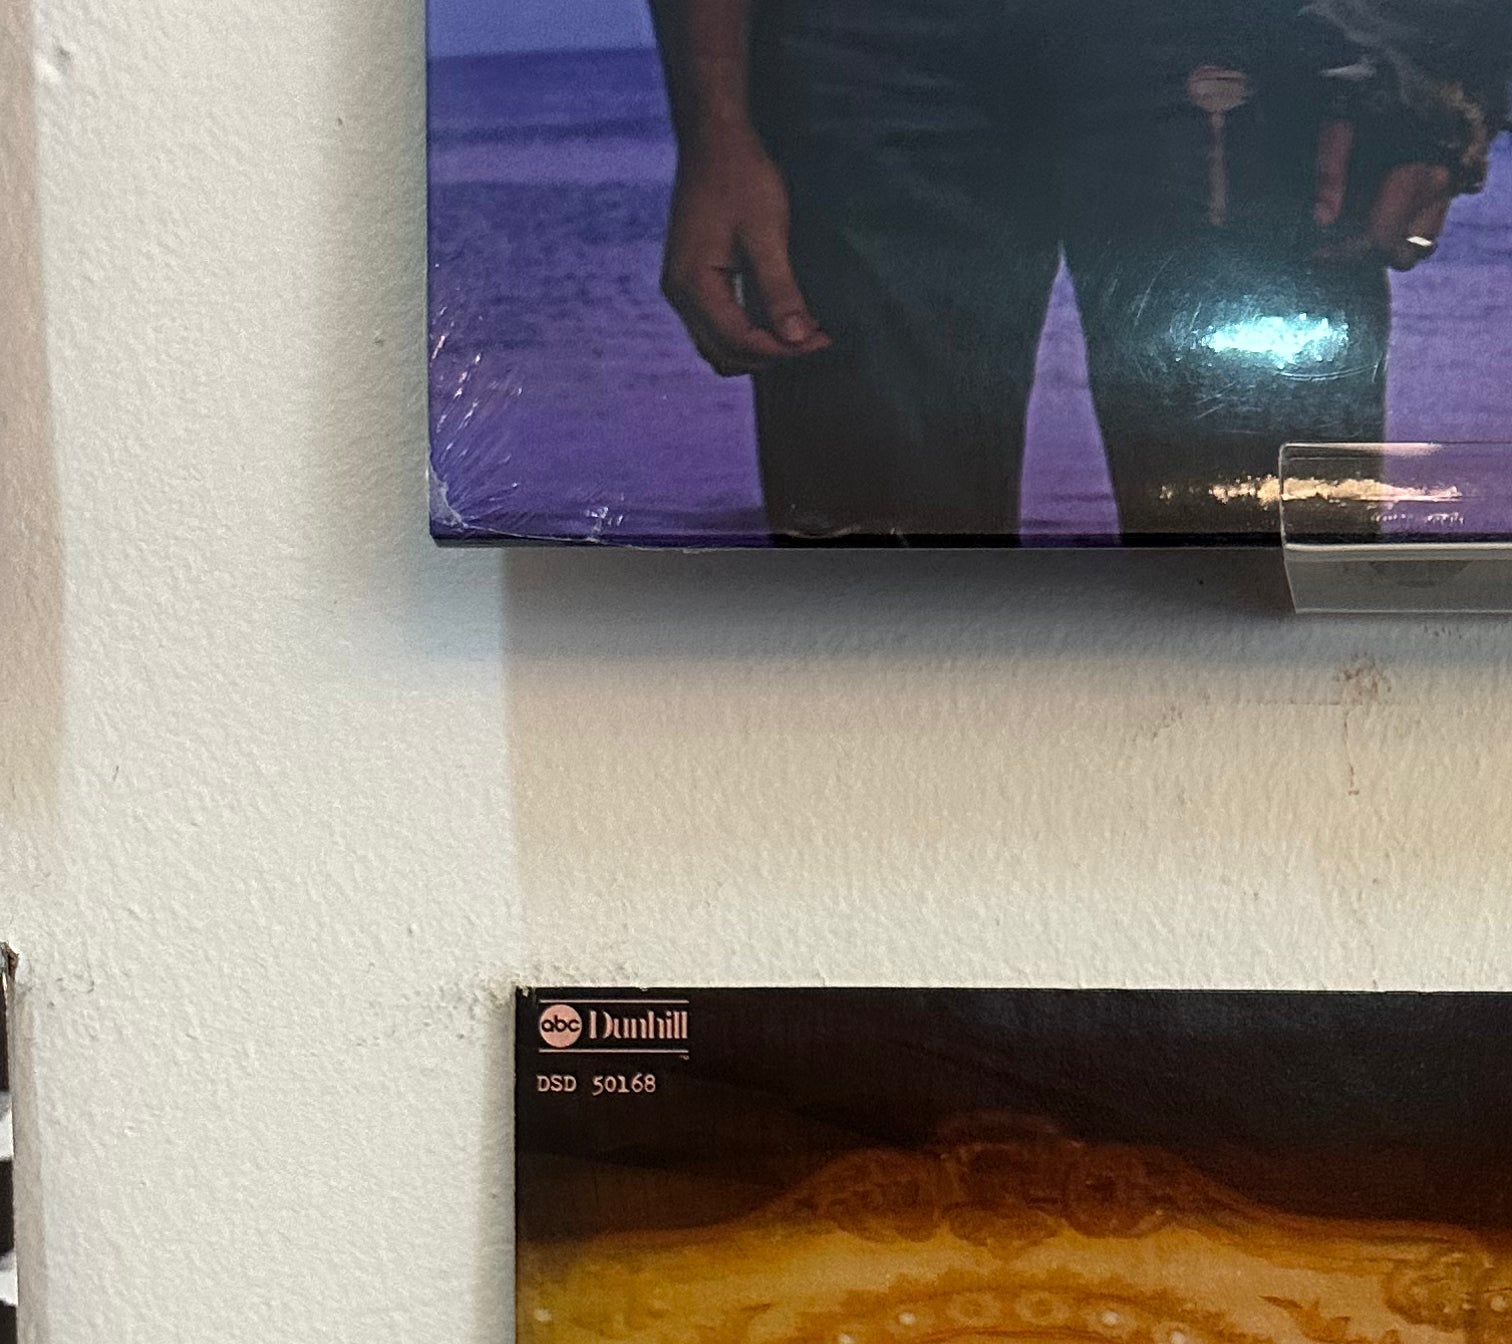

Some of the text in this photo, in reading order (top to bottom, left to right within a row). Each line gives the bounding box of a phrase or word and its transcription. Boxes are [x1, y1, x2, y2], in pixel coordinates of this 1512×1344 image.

[589, 1010, 688, 1040] Dunhill
[537, 1073, 656, 1096] DSD 50168
